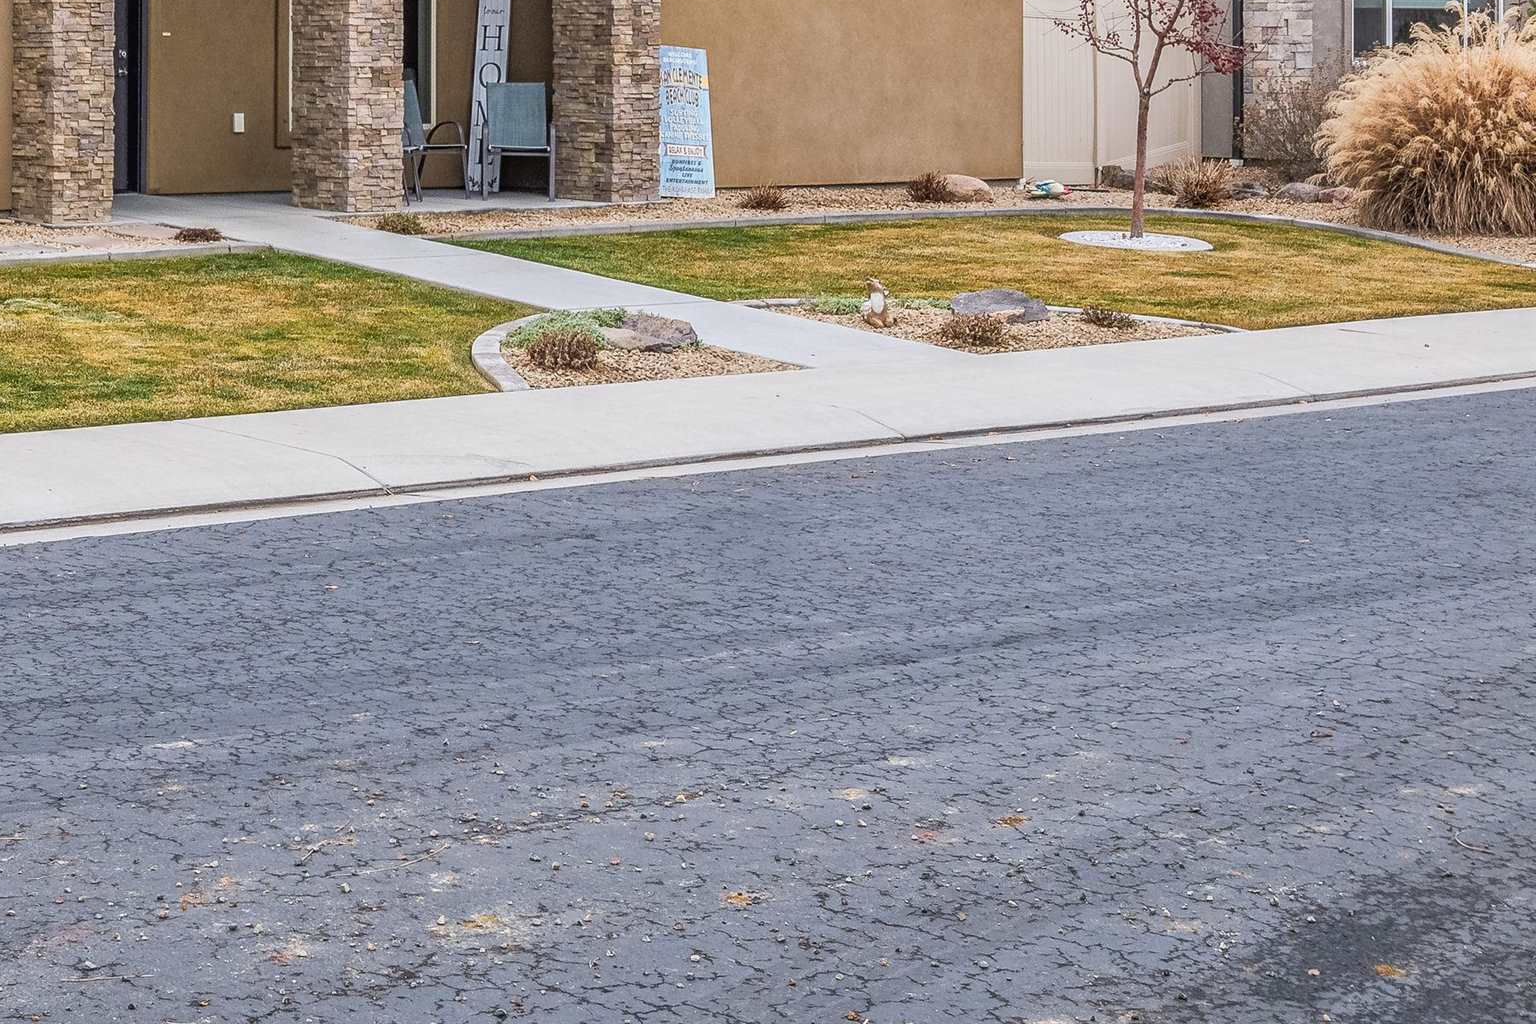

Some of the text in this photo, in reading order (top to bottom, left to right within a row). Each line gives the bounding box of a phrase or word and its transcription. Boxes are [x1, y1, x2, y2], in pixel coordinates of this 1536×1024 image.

[671, 66, 703, 90] CLEMENTE
[665, 87, 699, 107] BEACH CLUB
[668, 145, 682, 154] RELAX
